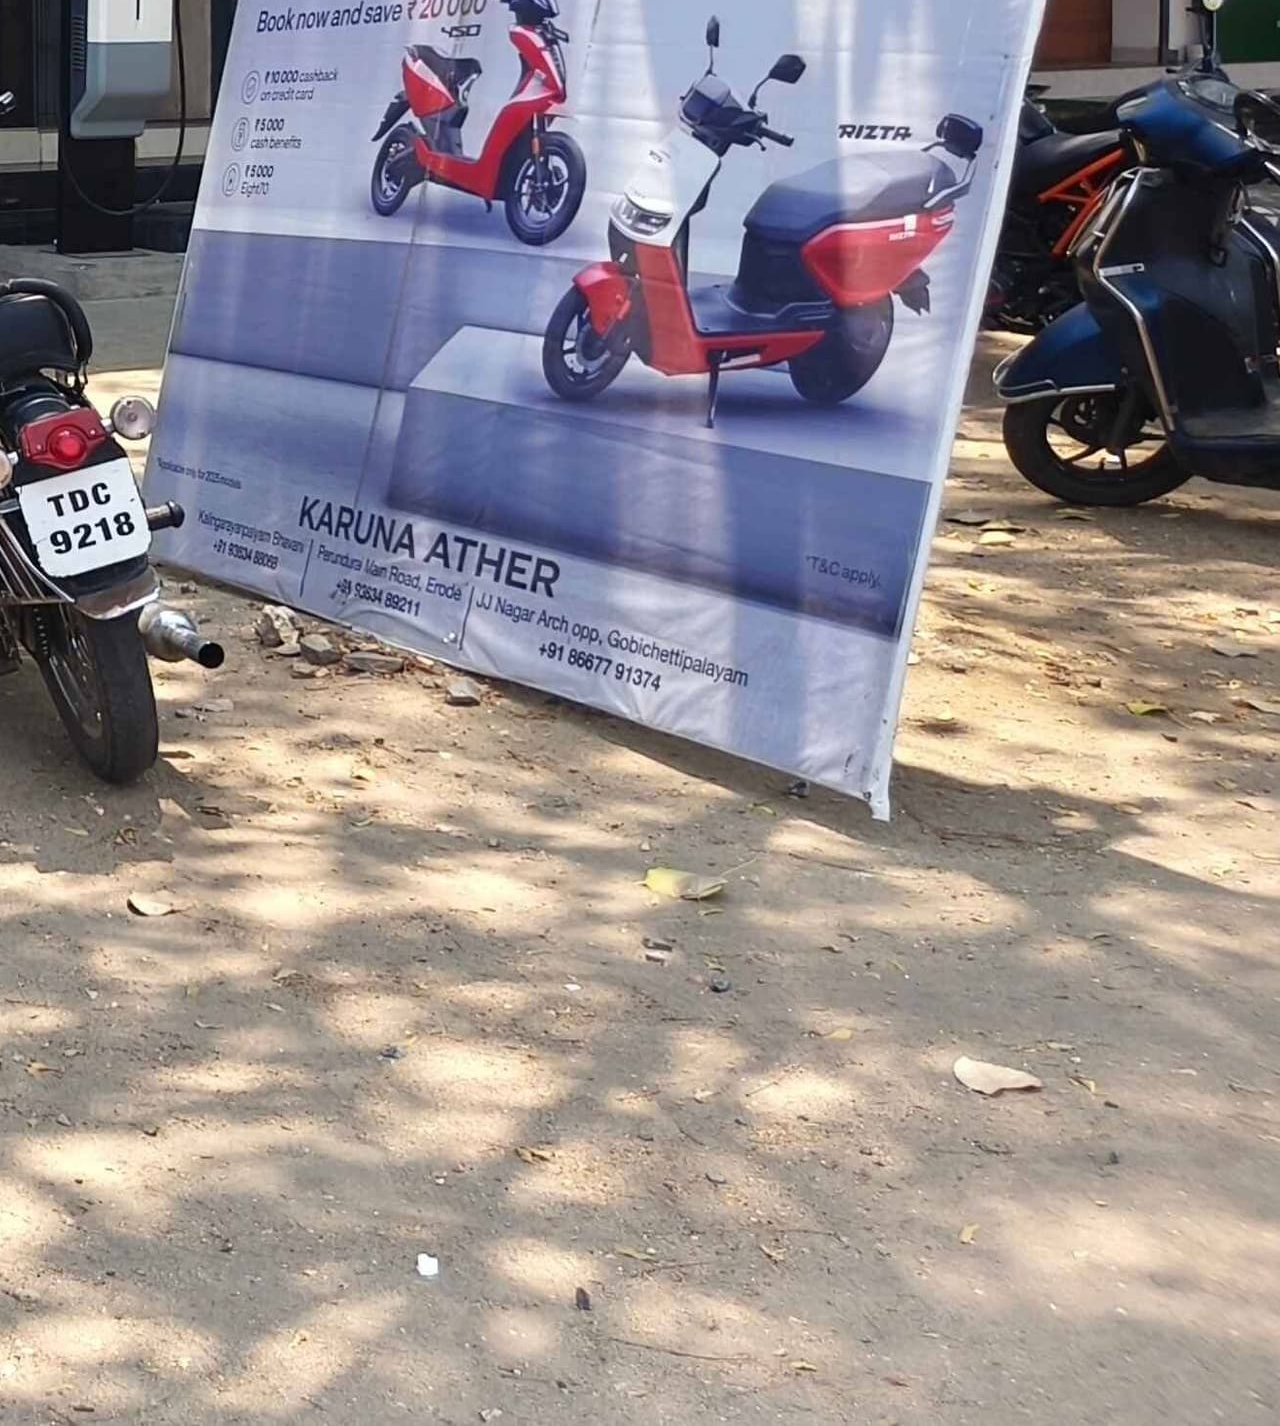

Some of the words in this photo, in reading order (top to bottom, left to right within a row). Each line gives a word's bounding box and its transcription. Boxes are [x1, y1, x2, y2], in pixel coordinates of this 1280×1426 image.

[256, 8, 295, 33] Book
[295, 11, 330, 30] now
[329, 2, 362, 26] and
[363, 2, 404, 24] save
[838, 124, 913, 141] RIZTA
[47, 482, 112, 517] TDC
[49, 511, 136, 555] 9218
[298, 494, 416, 559] KARUNA
[422, 531, 561, 600] ATHER
[388, 565, 422, 592] Road,
[425, 576, 463, 602] Erode
[841, 561, 883, 590] apply.
[384, 592, 422, 617] 89211
[475, 587, 492, 611] JJ
[494, 596, 536, 628] Nagar
[538, 608, 570, 635] Arch
[572, 622, 604, 648] opp,
[607, 629, 749, 687] Gobichettipalayam
[539, 642, 564, 665] +91
[567, 647, 613, 676] 86677
[614, 663, 662, 692] 91374
